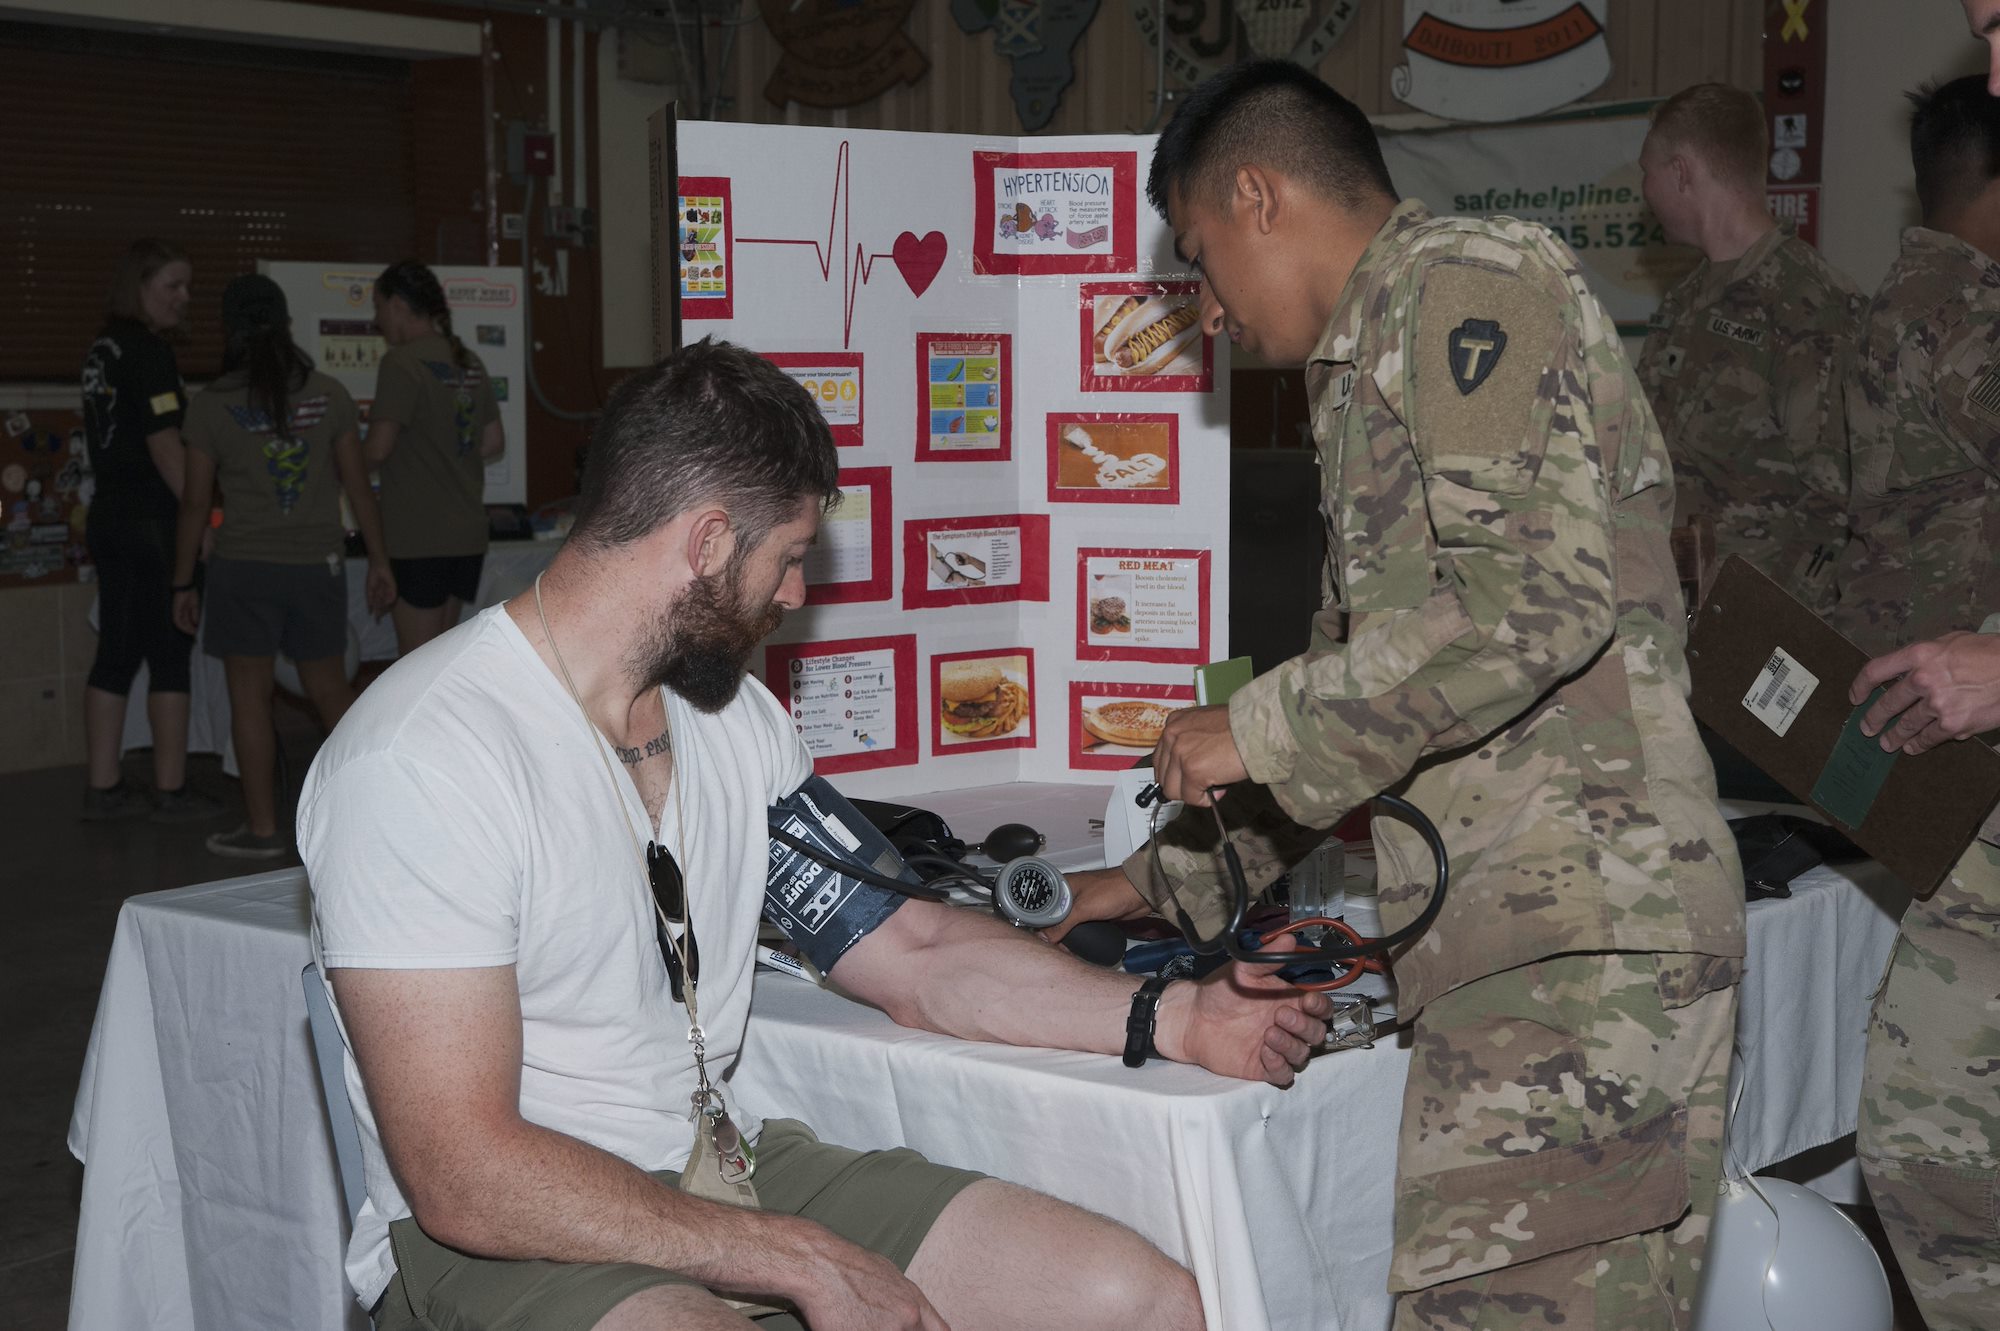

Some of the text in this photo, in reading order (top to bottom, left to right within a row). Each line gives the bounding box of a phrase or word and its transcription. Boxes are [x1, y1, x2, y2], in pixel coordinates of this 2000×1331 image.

[1420, 19, 1585, 59] DJIBOUTI 2011
[1163, 48, 1199, 81] EFS
[1040, 199, 1056, 207] HEART
[1766, 193, 1809, 218] FIRE
[1038, 206, 1058, 214] ATTACK
[1103, 457, 1154, 482] SALT
[941, 532, 966, 541] Symptoms
[1119, 561, 1175, 571] RED MEAT
[1155, 574, 1187, 582] cholesterol
[805, 657, 831, 666] Lifestyle
[831, 655, 855, 664] Changes
[831, 662, 848, 670] Blood
[848, 660, 872, 668] Pressure
[811, 679, 825, 687] Moving
[784, 861, 824, 908] DCUFF
[789, 875, 798, 886] BP
[779, 883, 791, 895] Cuff
[803, 871, 843, 925] ADC
[770, 951, 804, 968] FEDERAL
